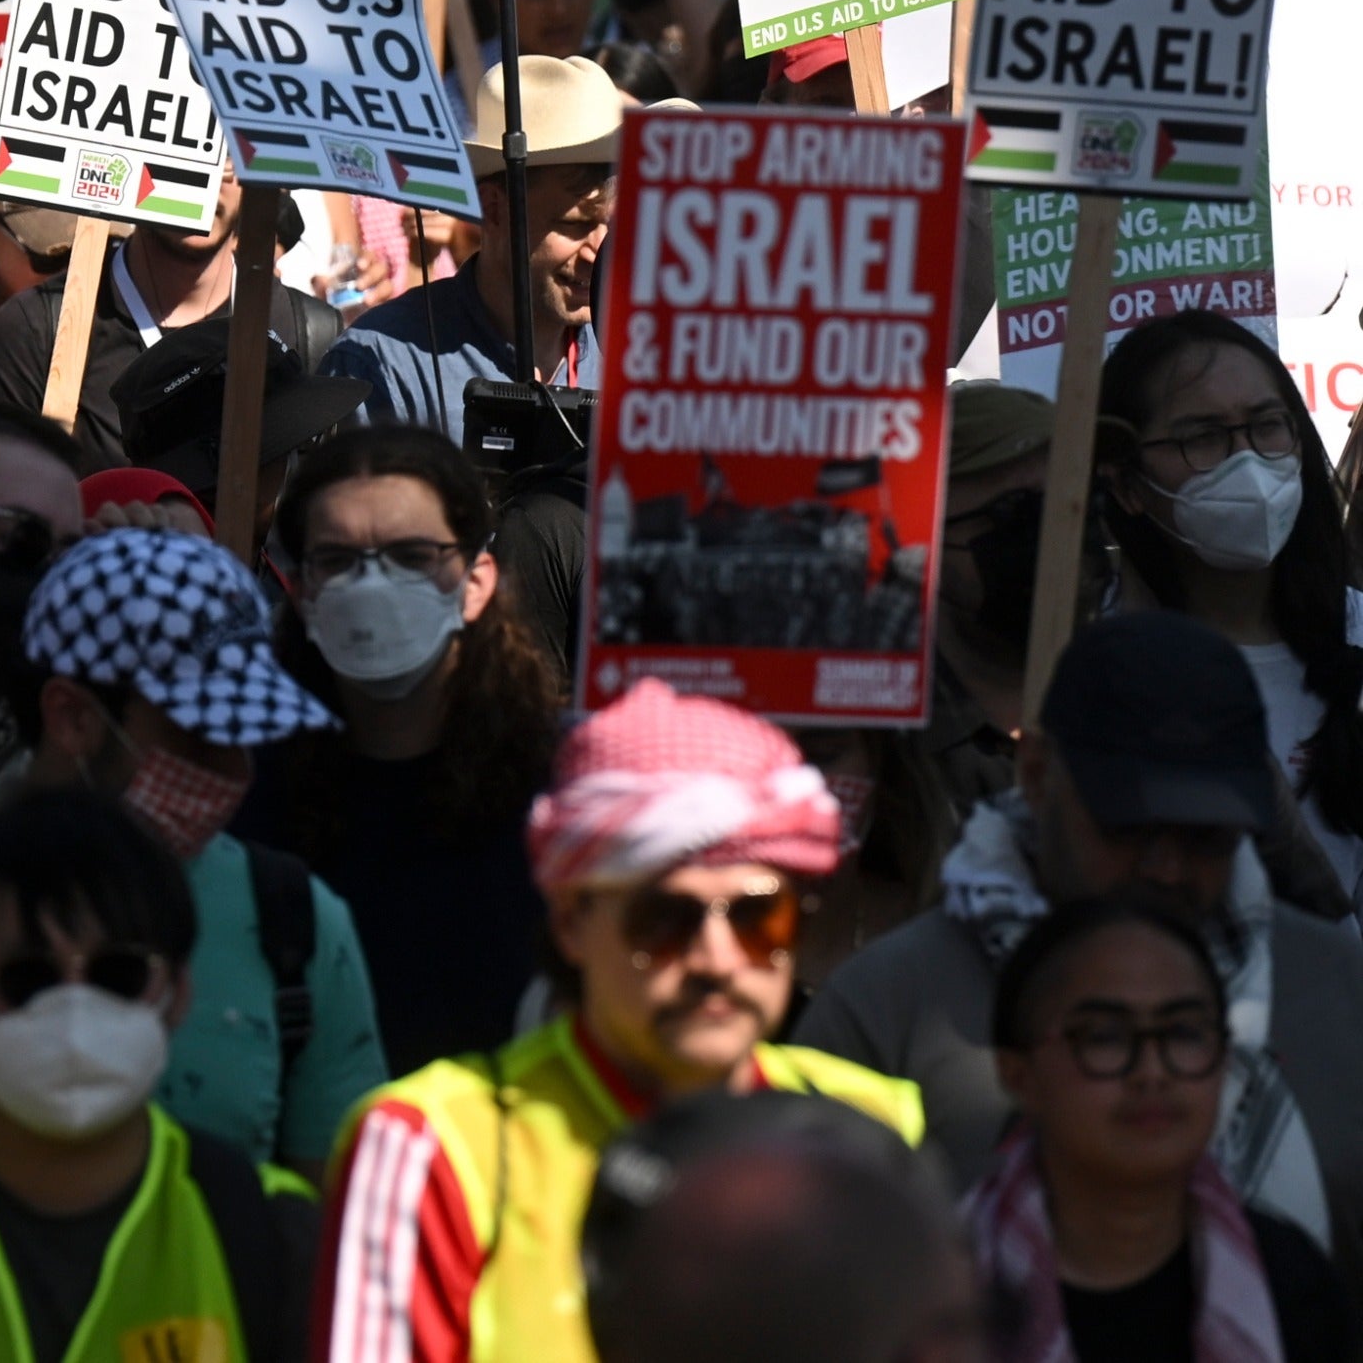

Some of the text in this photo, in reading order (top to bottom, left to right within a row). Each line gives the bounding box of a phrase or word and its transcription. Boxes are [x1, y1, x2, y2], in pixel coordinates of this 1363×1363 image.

[18, 2, 126, 68] AID
[201, 11, 422, 83] AID TO
[750, 25, 787, 50] END
[793, 14, 824, 39] U.S
[831, 2, 863, 28] AID
[984, 16, 1253, 102] ISRAEL!
[11, 66, 217, 153] ISRAEL!
[211, 66, 447, 140] ISRAEL!
[80, 168, 112, 184] DNC
[639, 118, 946, 192] STOP ARMING
[77, 181, 120, 201] 2024
[1182, 198, 1257, 230] AND
[631, 188, 934, 314] ISRAEL
[1170, 278, 1265, 313] WAR!
[164, 374, 190, 393] adidas
[623, 311, 928, 391] & FUND OUR
[618, 390, 923, 461] COMMUNITIES
